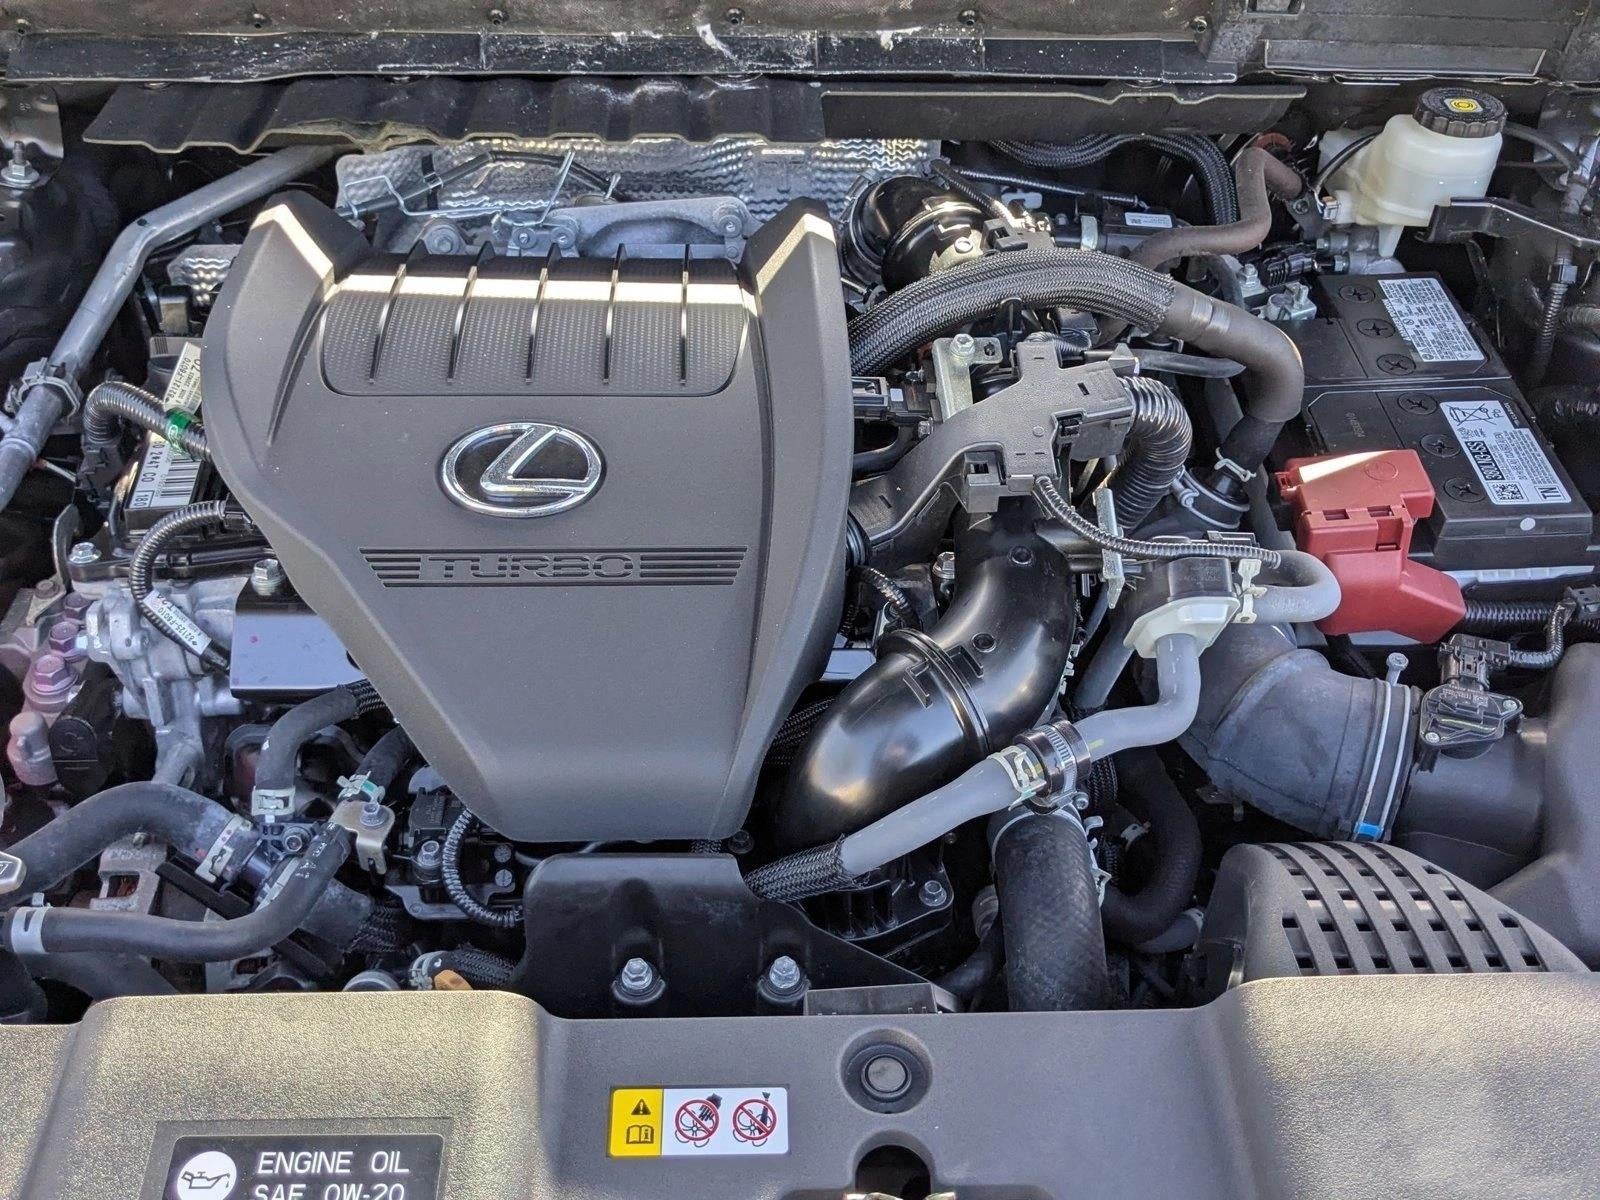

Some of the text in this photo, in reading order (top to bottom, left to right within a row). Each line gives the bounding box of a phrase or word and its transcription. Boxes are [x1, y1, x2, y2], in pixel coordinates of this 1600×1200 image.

[1491, 408, 1505, 418] Pb
[1538, 487, 1561, 499] TN
[428, 554, 634, 578] TURBO
[257, 1151, 410, 1174] ENGINE OIL
[252, 1184, 405, 1200] SAE 0W-20
